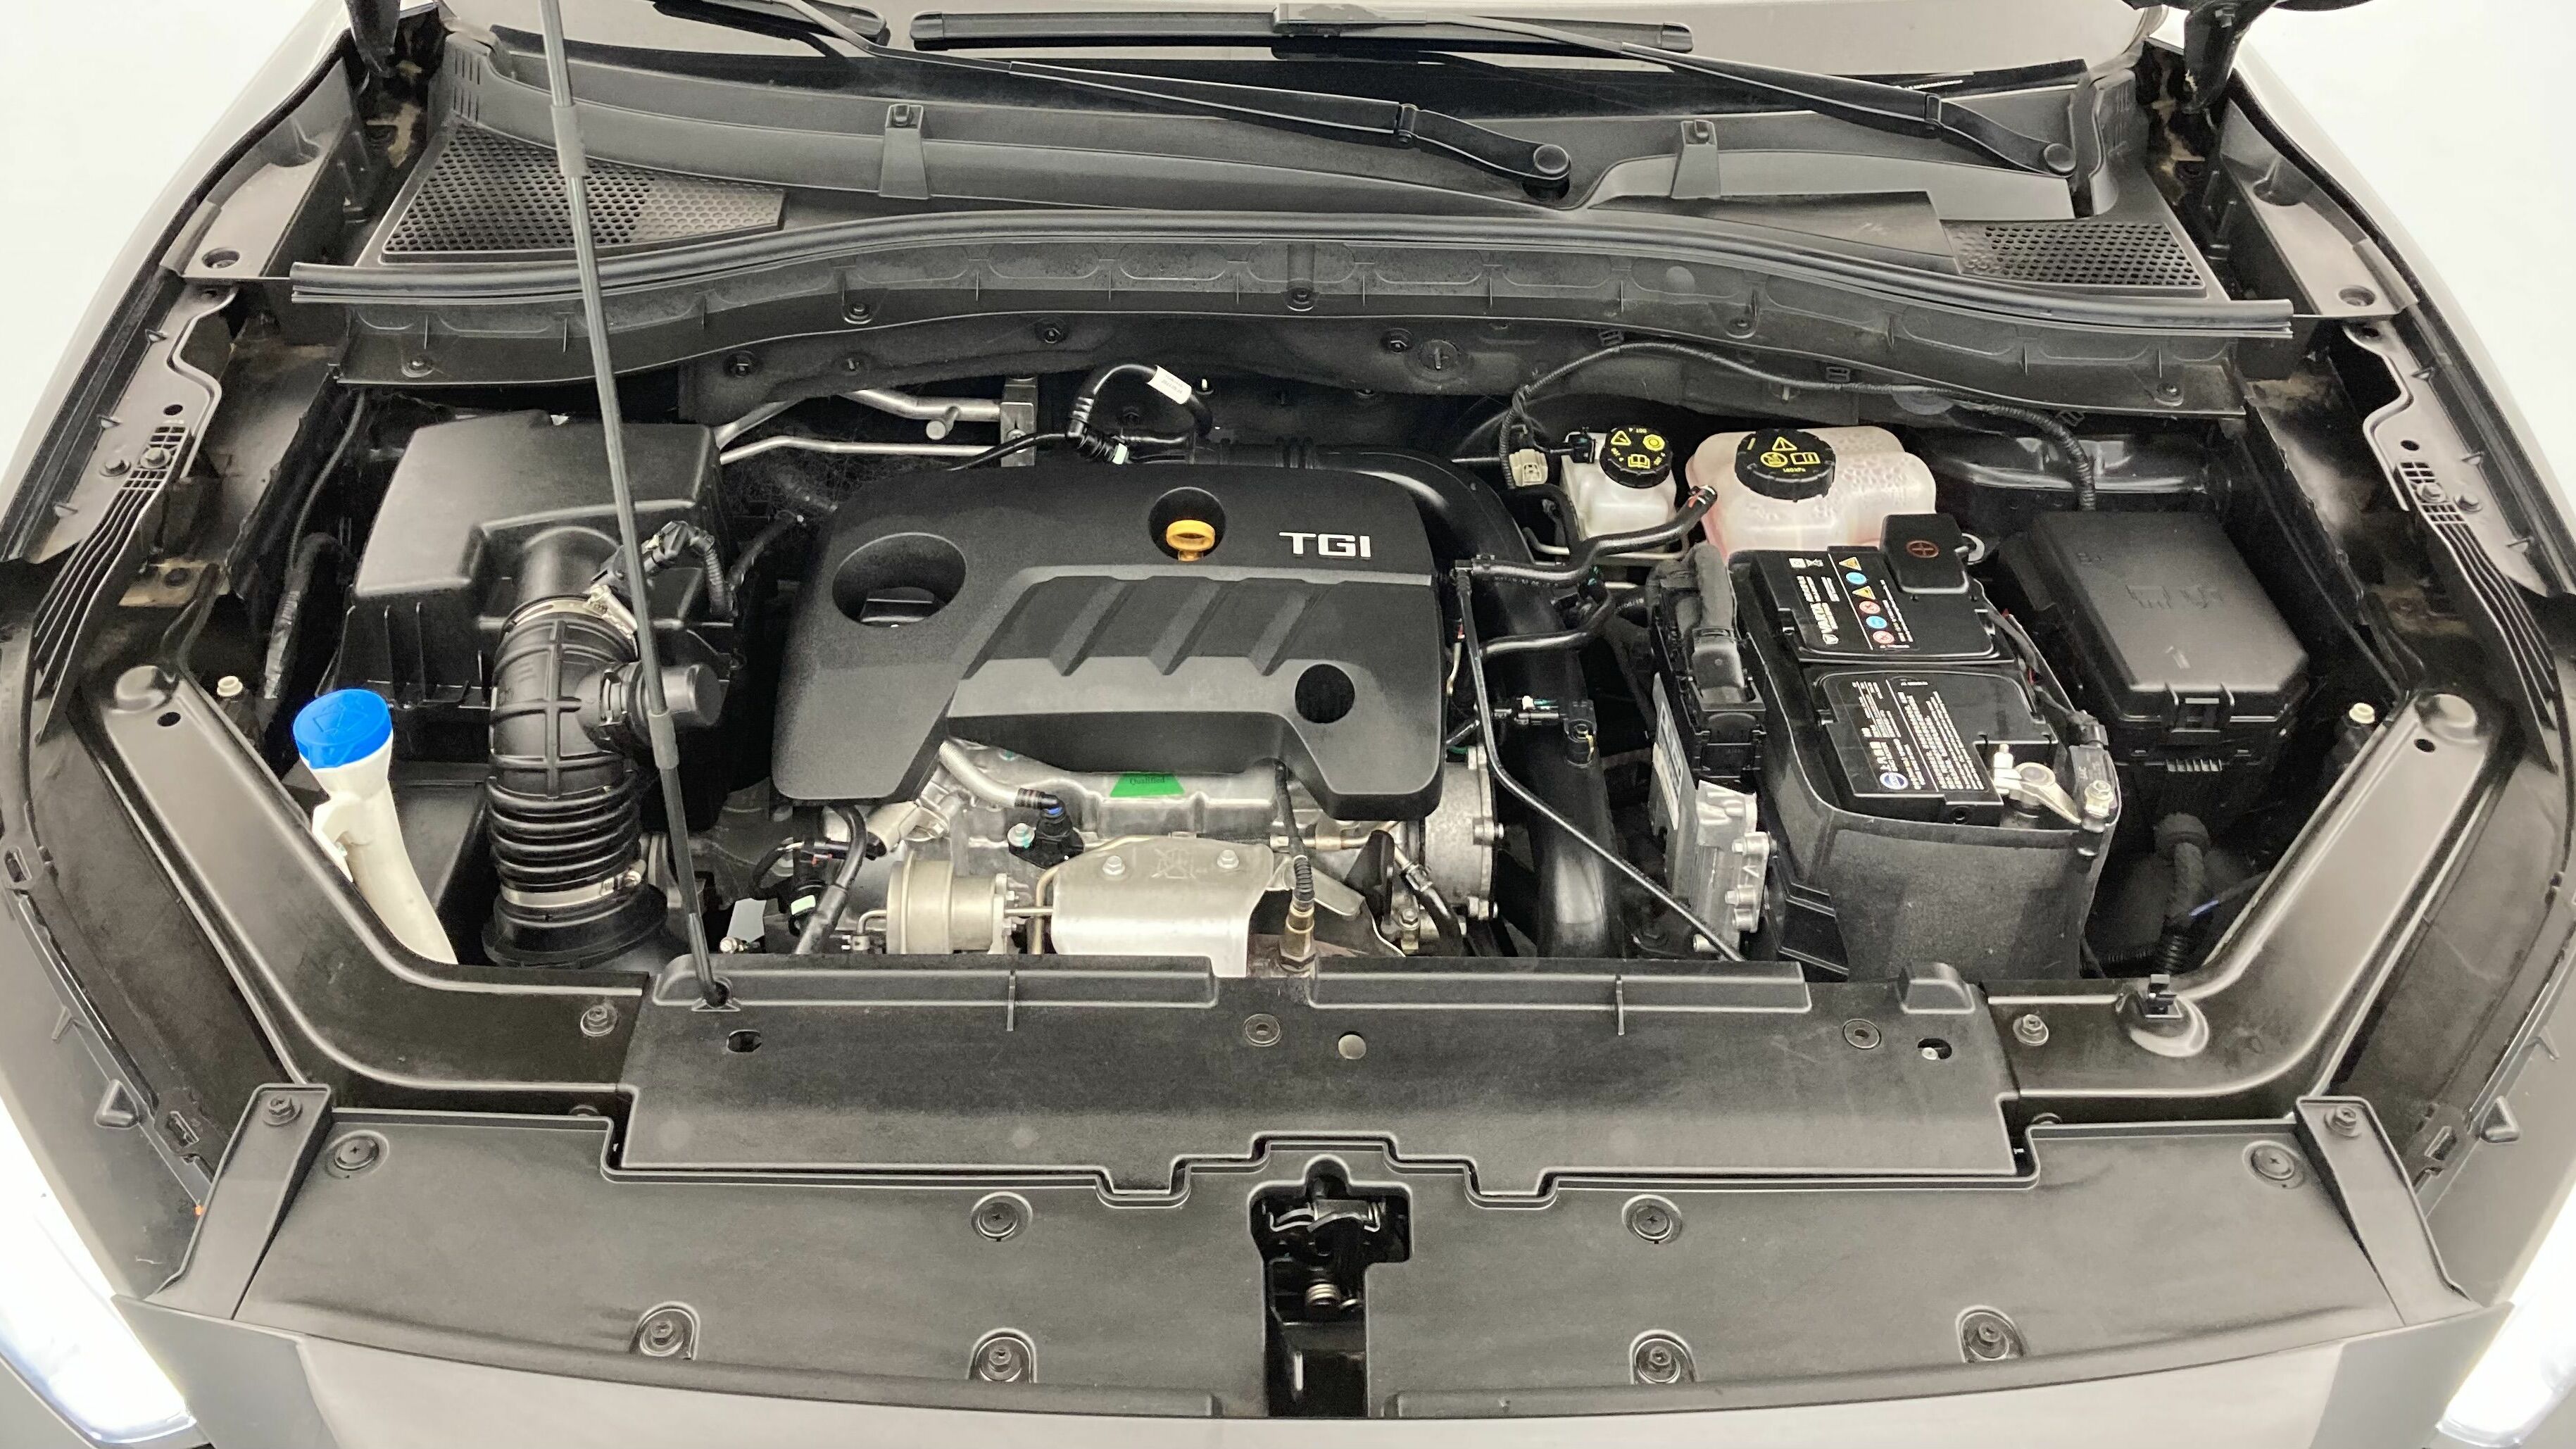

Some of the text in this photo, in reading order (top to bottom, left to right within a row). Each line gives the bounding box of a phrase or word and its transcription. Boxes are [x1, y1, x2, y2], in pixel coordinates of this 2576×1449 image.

[1278, 531, 1371, 558] TGI
[1810, 602, 1833, 634] VARTA
[1129, 774, 1165, 785] Qualified
